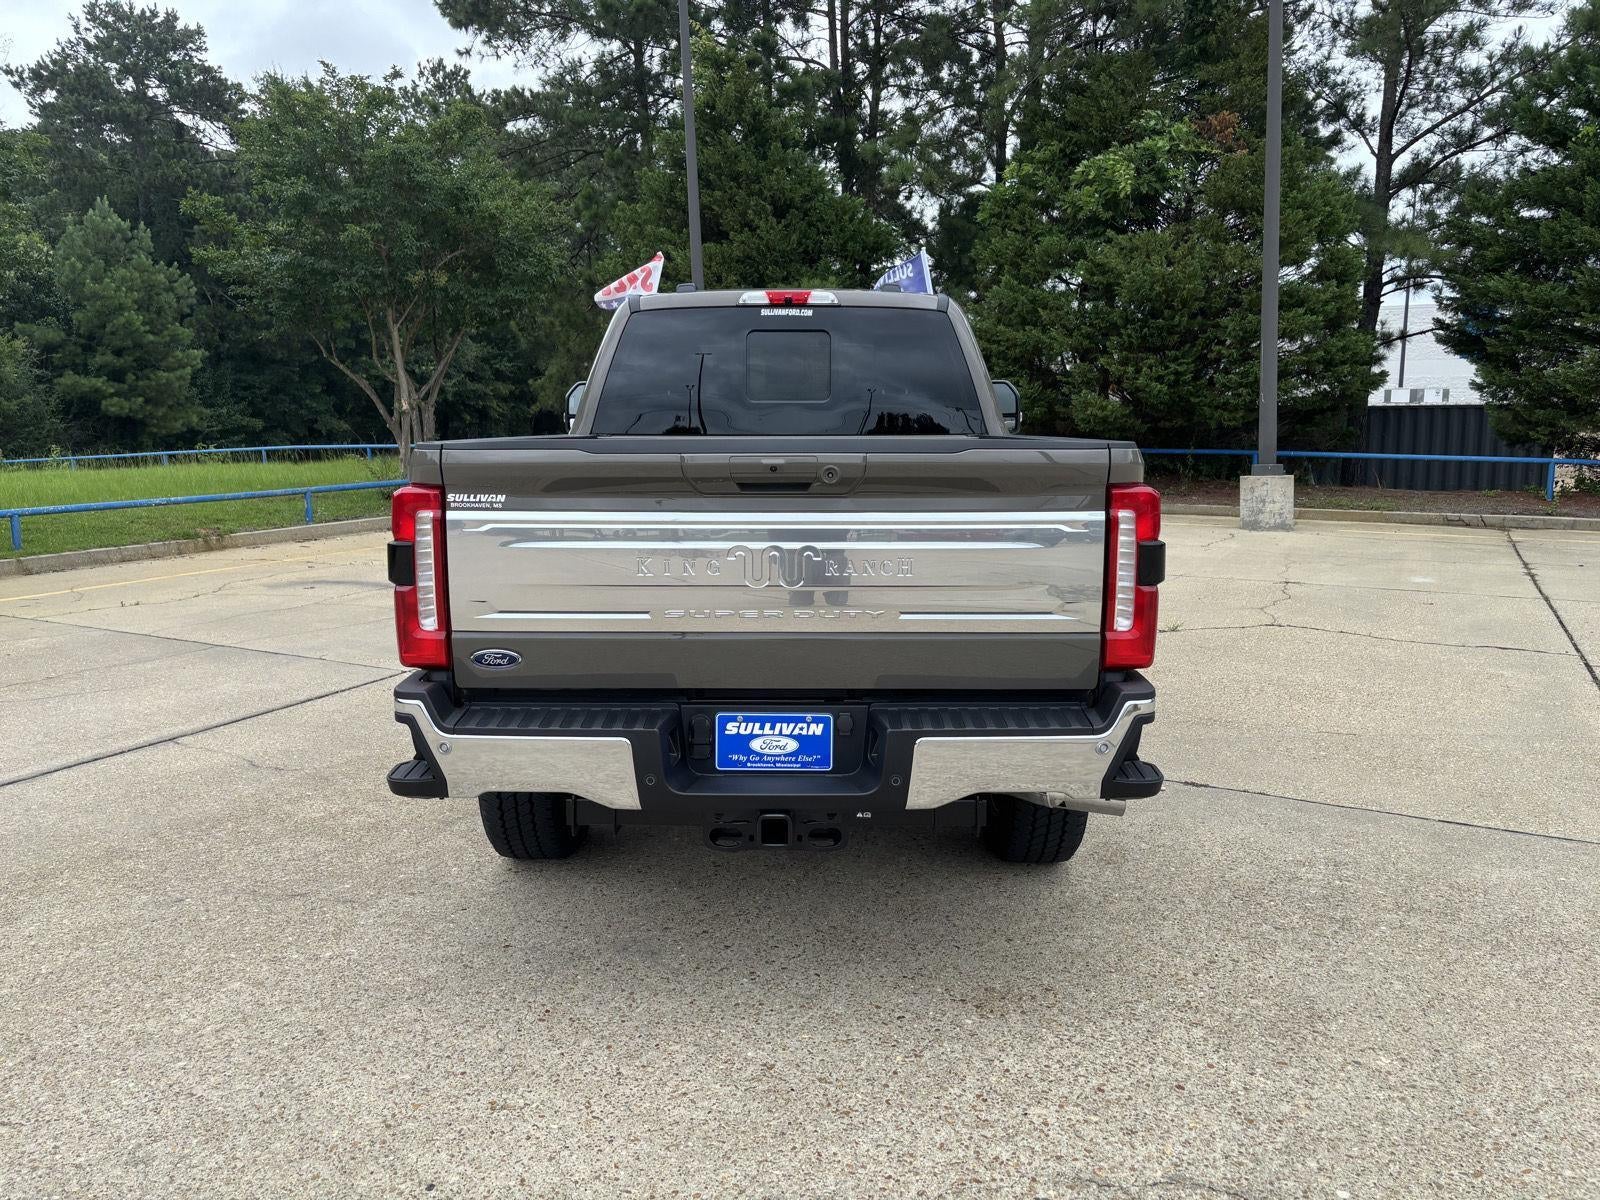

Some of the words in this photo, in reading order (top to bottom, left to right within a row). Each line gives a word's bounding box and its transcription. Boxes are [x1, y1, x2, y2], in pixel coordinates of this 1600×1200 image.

[446, 493, 506, 502] SULLIVAN
[636, 556, 721, 577] KING
[824, 556, 915, 577] RANCH
[663, 609, 784, 619] SUPER
[793, 609, 886, 619] DUTY
[481, 653, 510, 665] Ford
[724, 722, 824, 735] SULLIVAN
[759, 738, 789, 752] Ford
[762, 754, 796, 763] Anywhere
